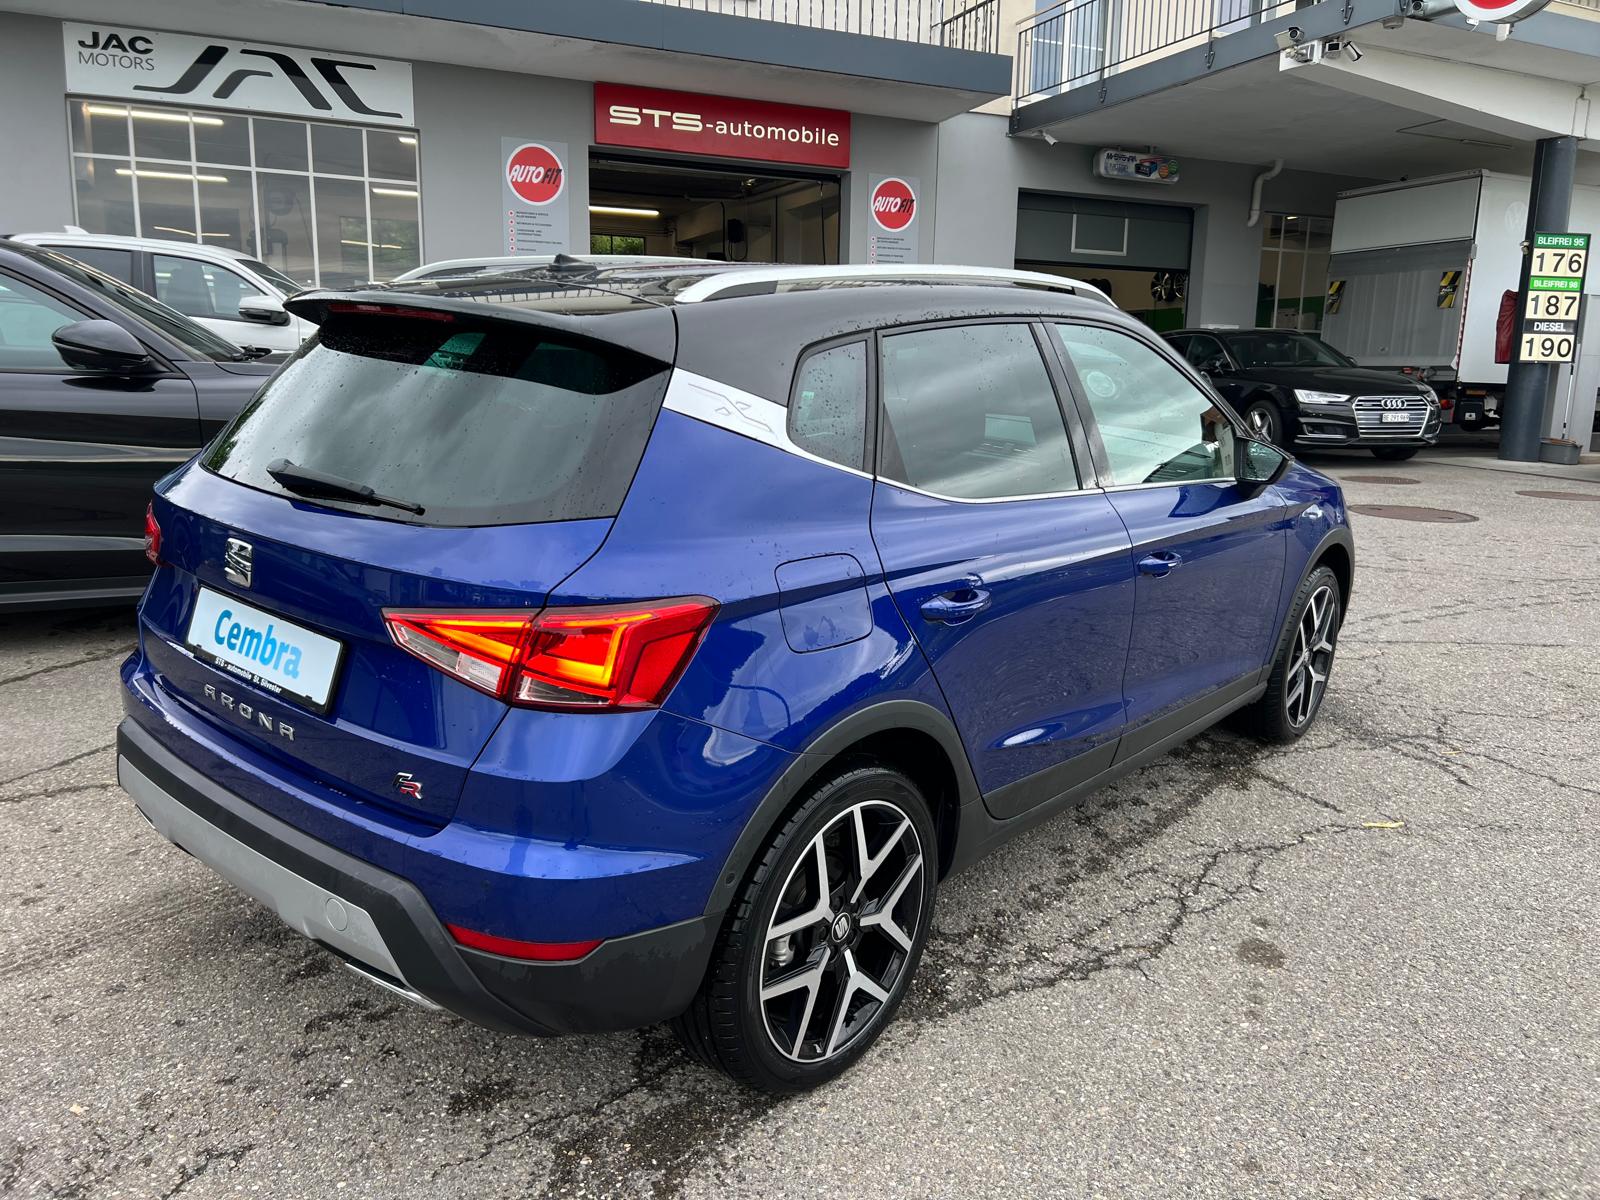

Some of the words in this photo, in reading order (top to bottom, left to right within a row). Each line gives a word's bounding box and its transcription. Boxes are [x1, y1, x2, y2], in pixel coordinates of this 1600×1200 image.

[78, 31, 154, 55] JAC
[78, 51, 155, 71] MOTORS
[1537, 236, 1572, 246] BLEIFREI
[1573, 238, 1584, 247] 95
[1535, 252, 1582, 273] 176
[1533, 279, 1568, 288] BLEIFREI
[1569, 281, 1578, 289] 98
[1530, 294, 1577, 316] 187
[1533, 321, 1566, 332] DIESEL
[1525, 337, 1572, 358] 190
[214, 609, 303, 680] Cembra
[260, 678, 282, 693] Silvester
[204, 684, 296, 742] ARONA
